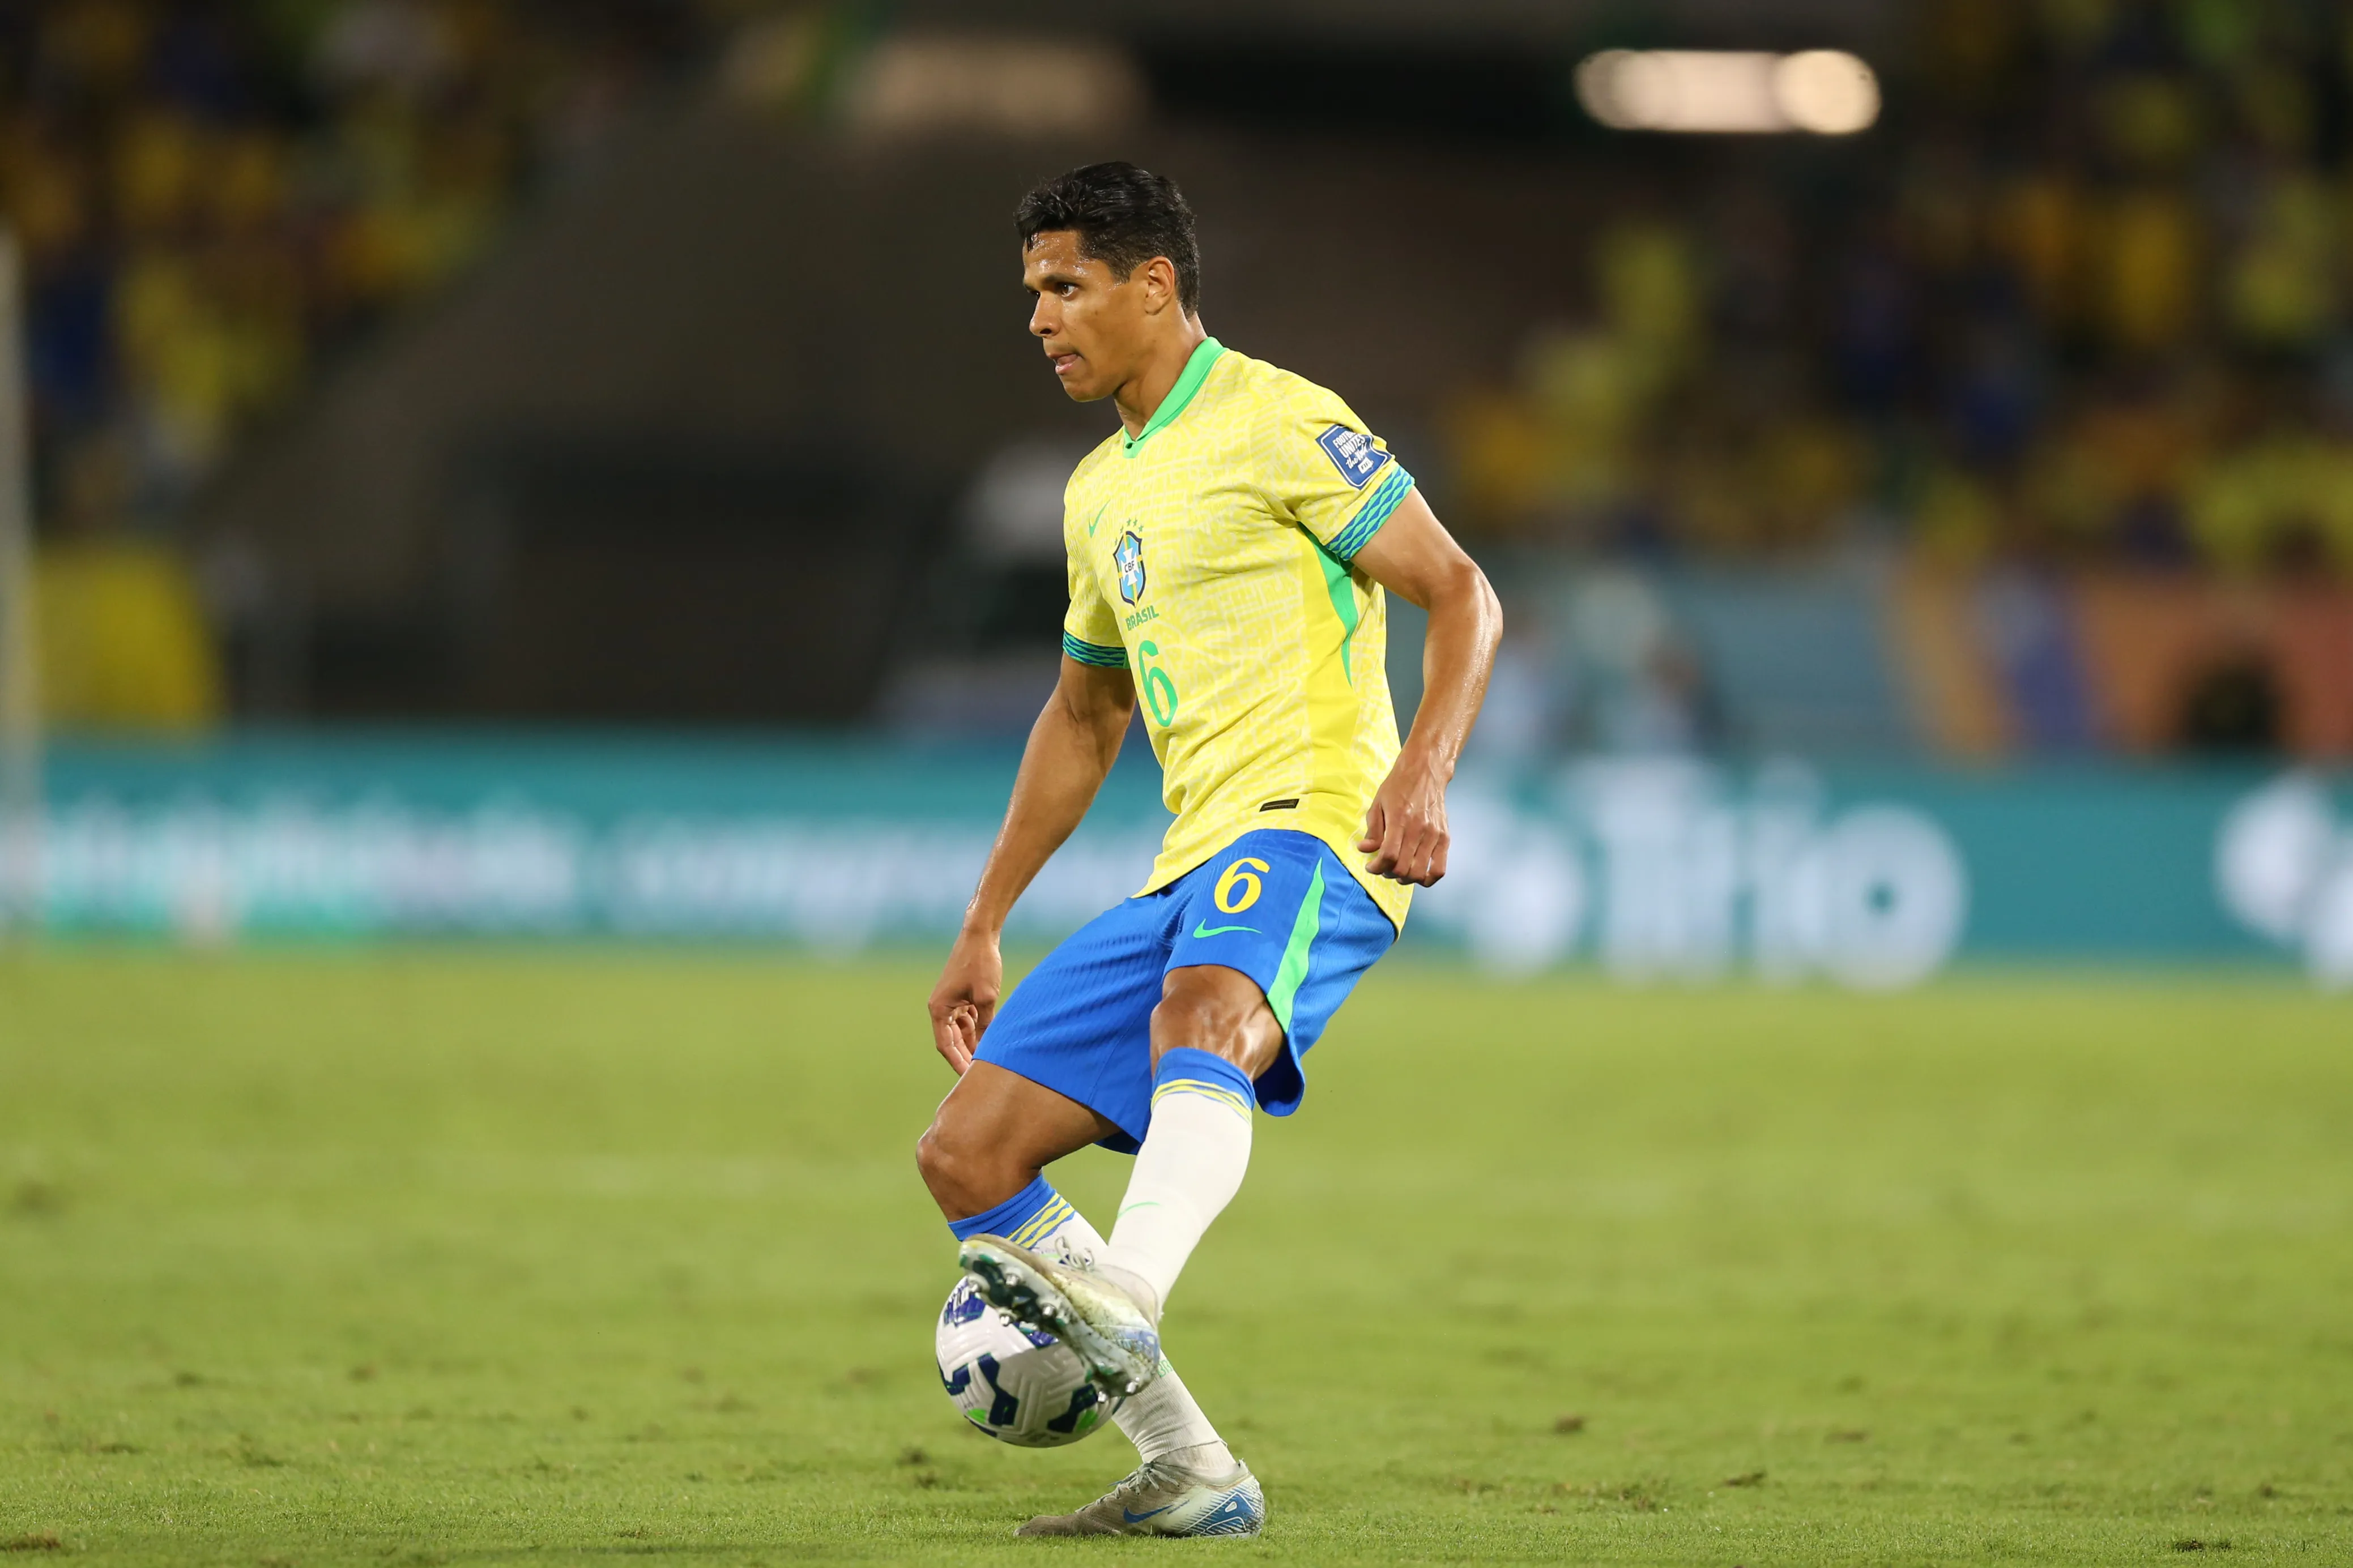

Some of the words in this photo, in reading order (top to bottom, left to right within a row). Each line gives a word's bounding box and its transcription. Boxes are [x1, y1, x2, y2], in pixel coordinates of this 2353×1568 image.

[1339, 434, 1365, 458] UNITES
[1124, 561, 1135, 573] CBF
[1125, 605, 1159, 631] BRASIL
[1139, 640, 1178, 727] 6
[1214, 857, 1270, 913] 6
